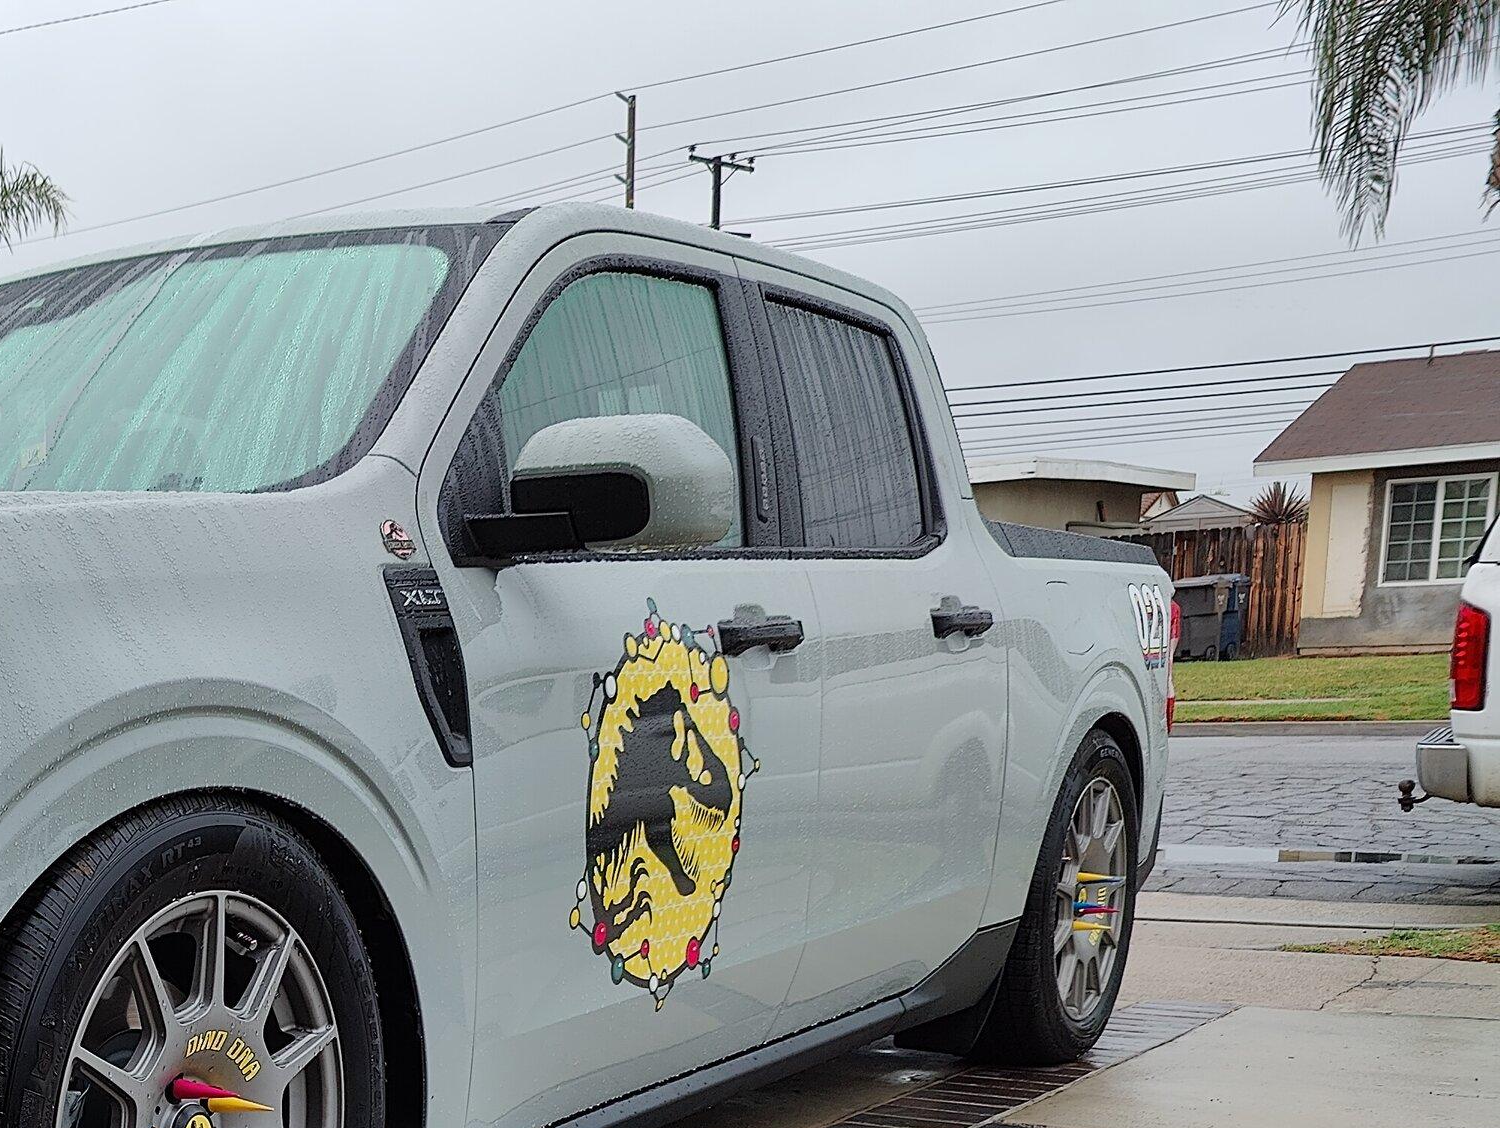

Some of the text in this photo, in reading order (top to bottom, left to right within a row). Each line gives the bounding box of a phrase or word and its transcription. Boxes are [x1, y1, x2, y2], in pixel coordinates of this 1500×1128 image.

[400, 589, 444, 607] XLT
[1128, 583, 1168, 653] 021
[185, 1030, 261, 1082] DINO DNA
